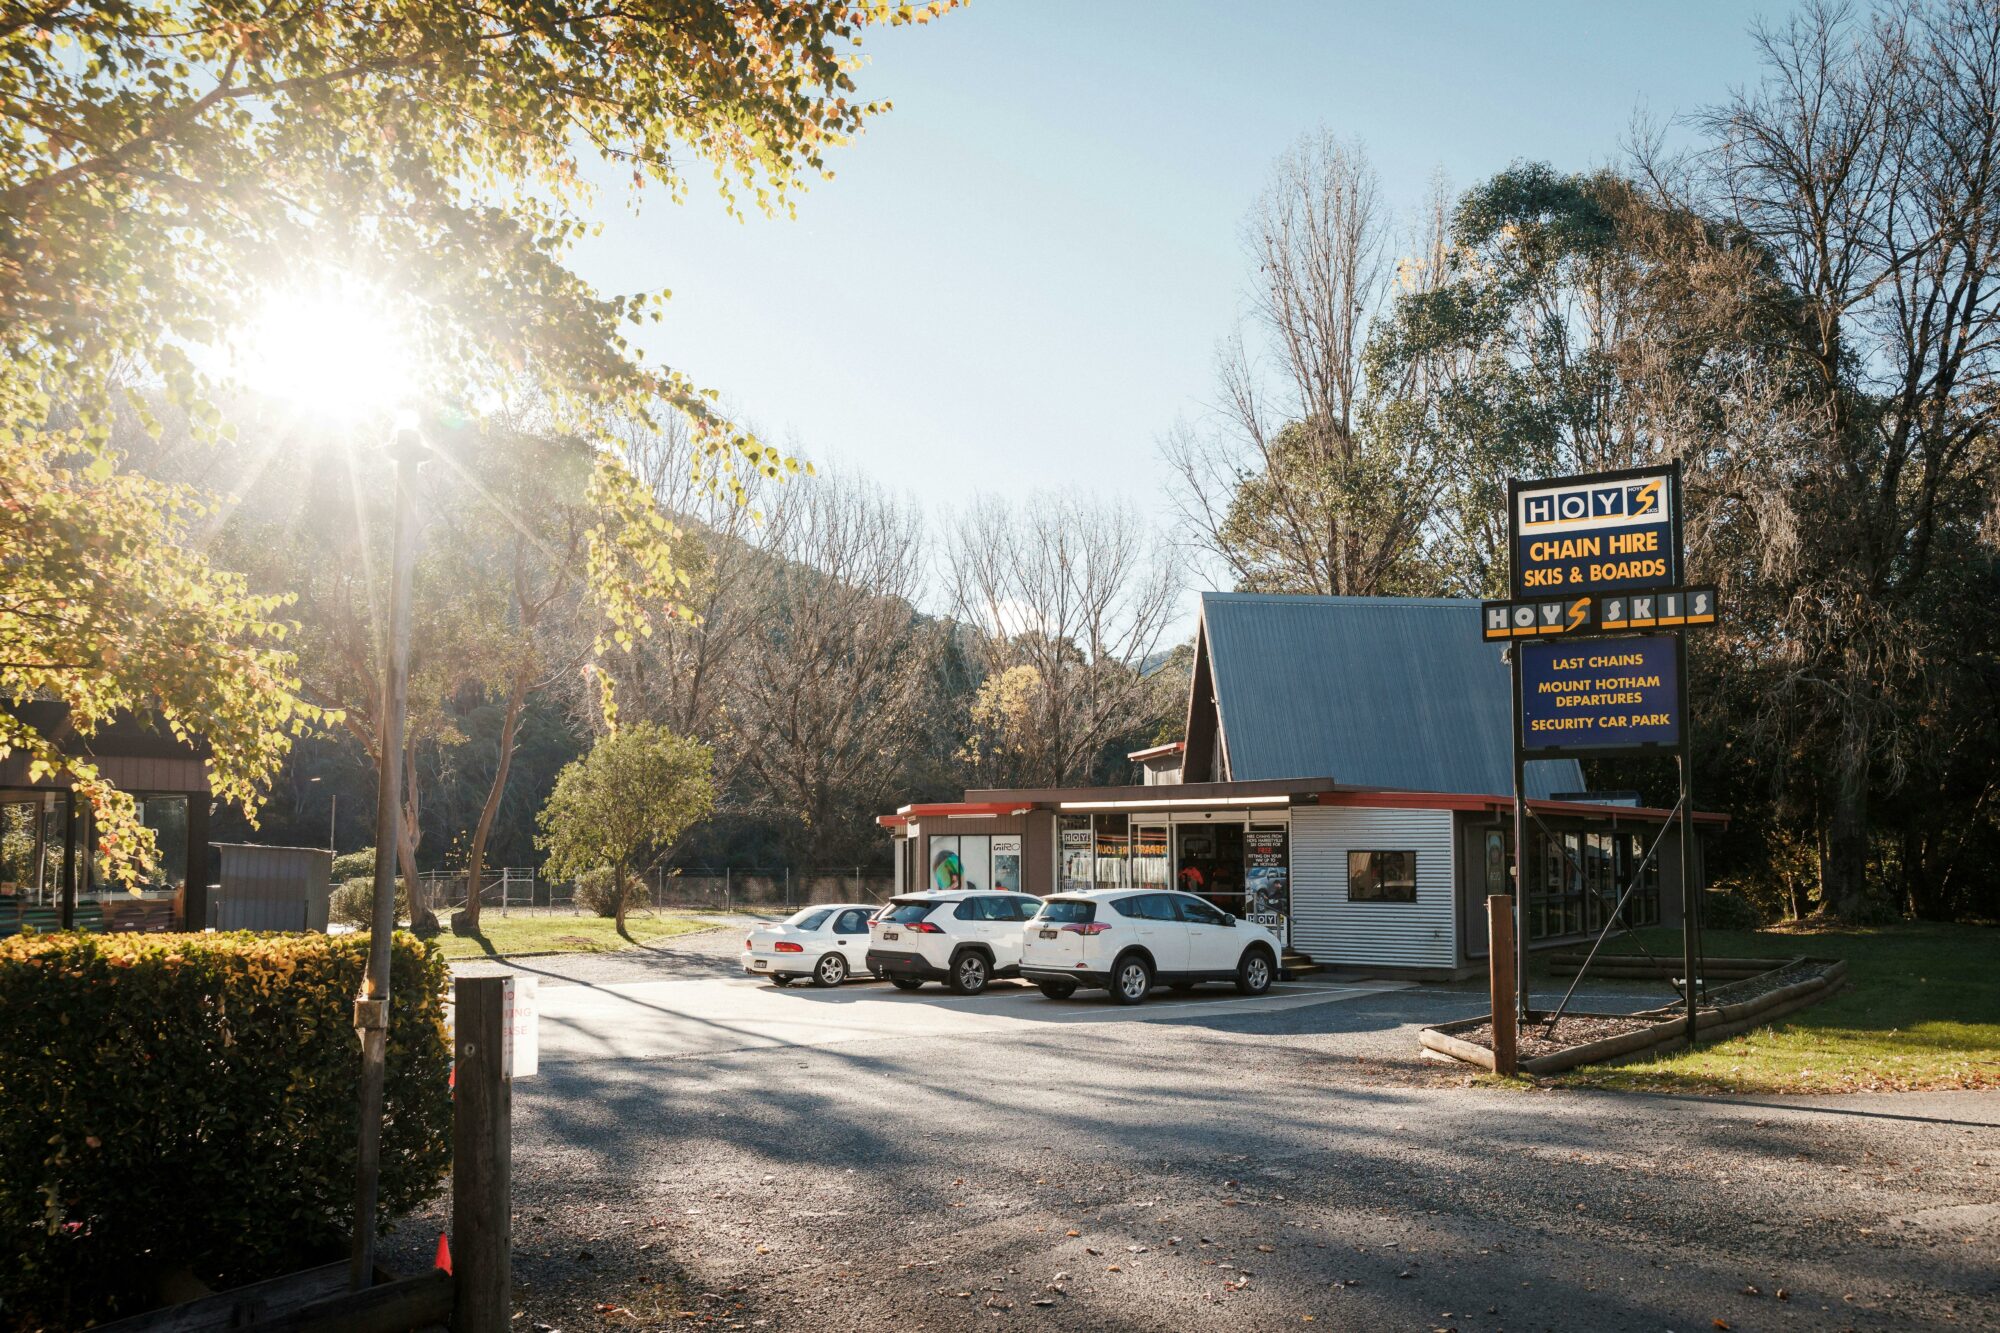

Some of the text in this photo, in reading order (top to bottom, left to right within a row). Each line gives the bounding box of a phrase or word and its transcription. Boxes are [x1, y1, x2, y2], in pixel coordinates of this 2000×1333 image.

[1529, 480, 1662, 522] HOYS
[1529, 531, 1658, 562] CHAIN HIRE
[1524, 559, 1666, 587] SKIS & BOARDS
[1489, 593, 1707, 632] HOYS SKIS
[1552, 654, 1644, 670] LAST CHAINS
[1538, 676, 1660, 693] MOUNT HOTHAM
[1556, 692, 1642, 708] DEPARTURES
[1531, 713, 1670, 731] SECURITY CAR PARK
